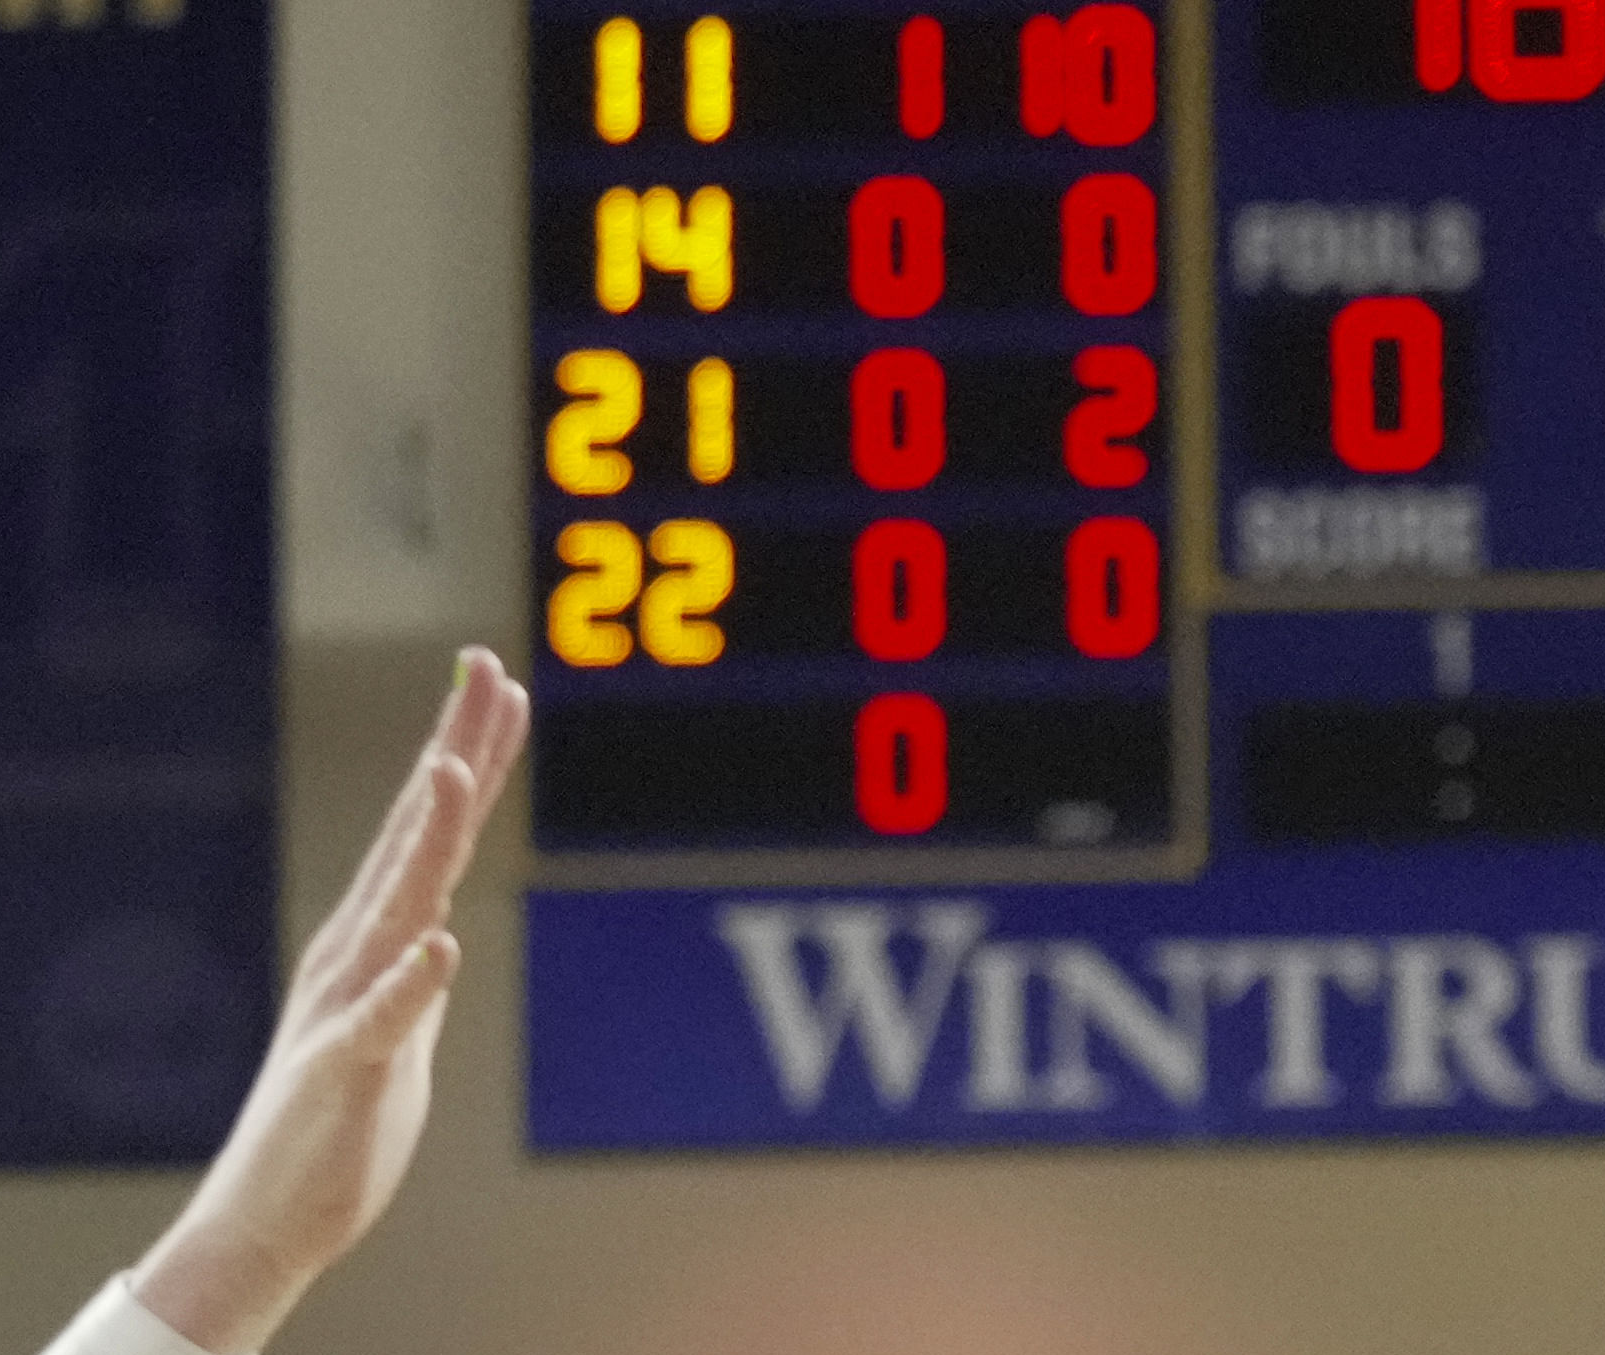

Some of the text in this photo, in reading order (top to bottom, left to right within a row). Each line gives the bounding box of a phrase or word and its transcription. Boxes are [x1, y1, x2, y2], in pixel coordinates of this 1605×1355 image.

[595, 3, 1156, 147] 11 1 10
[596, 172, 1157, 318] 14 0 0
[1232, 201, 1481, 292] FOULS
[546, 344, 1157, 495] 21 0 2
[1329, 295, 1444, 472] 0
[547, 515, 1159, 667] 22 0 0
[855, 691, 948, 835] 0
